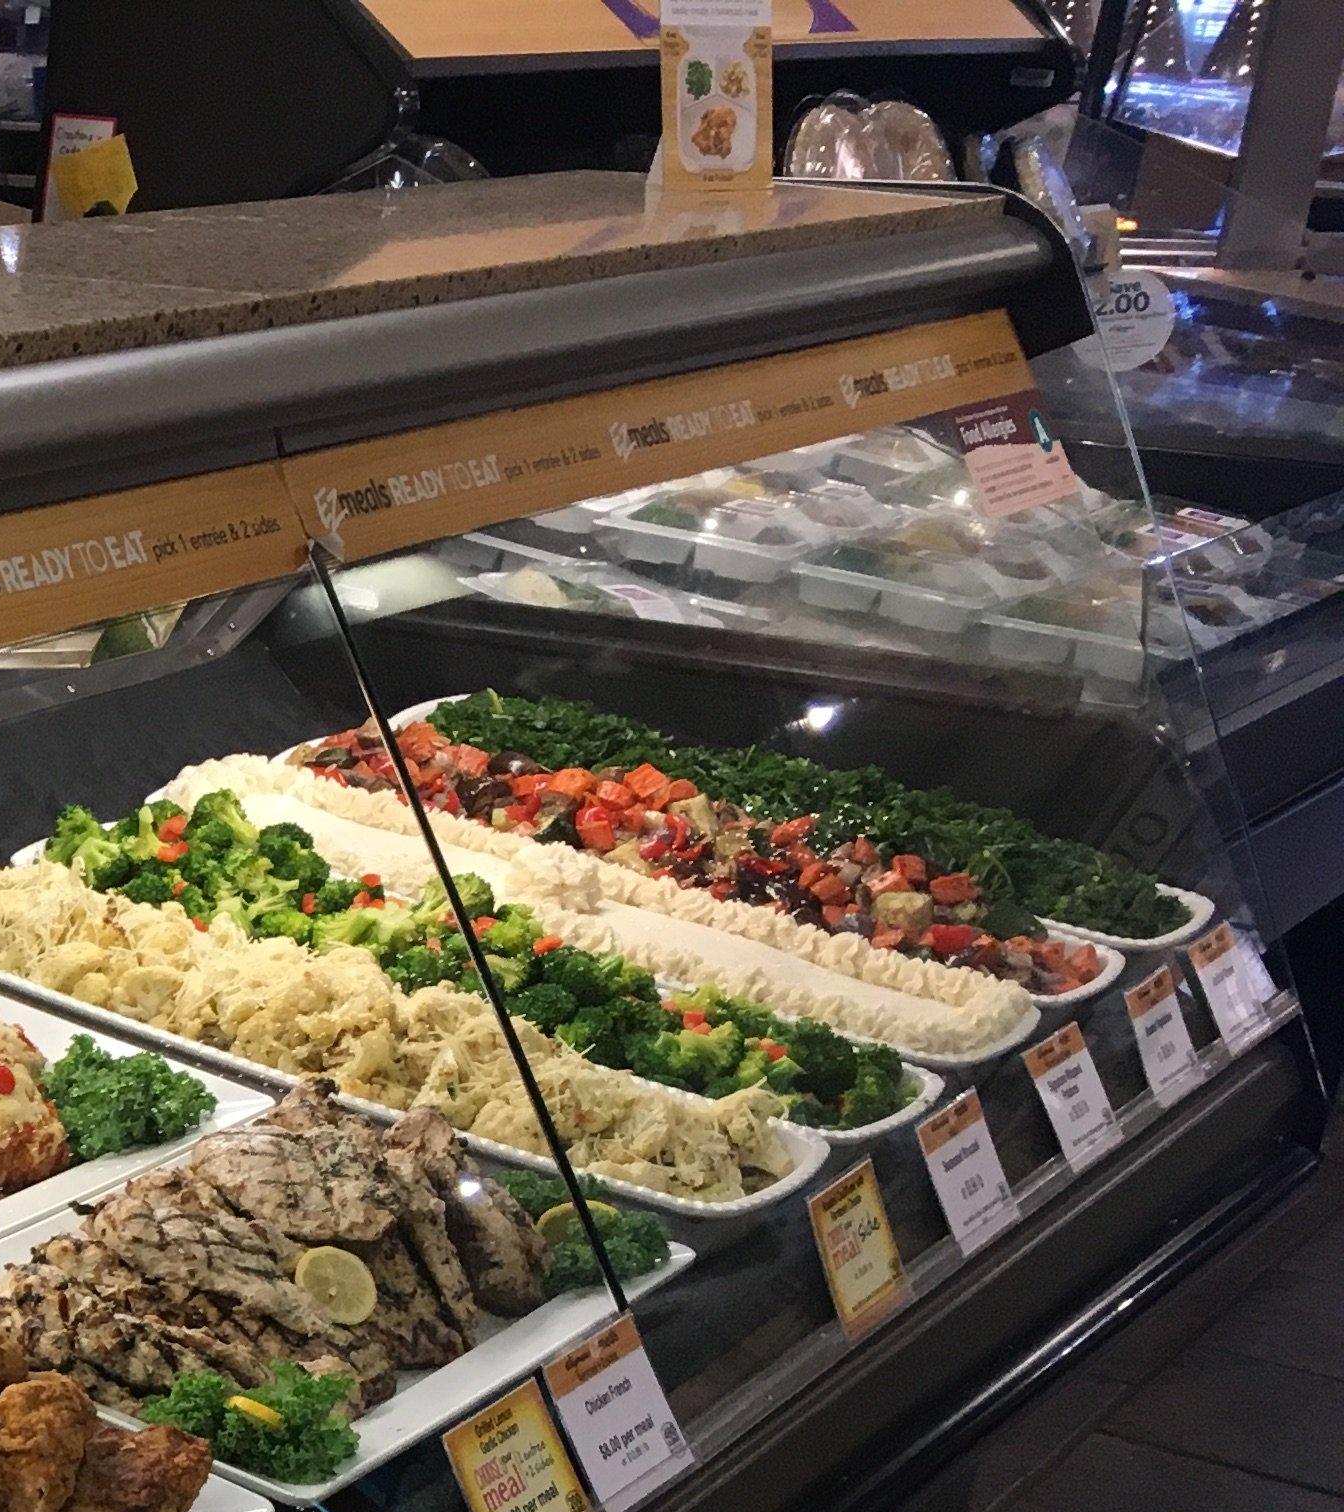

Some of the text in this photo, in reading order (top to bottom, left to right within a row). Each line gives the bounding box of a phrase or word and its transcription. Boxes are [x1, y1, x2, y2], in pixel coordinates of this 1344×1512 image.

[387, 467, 447, 506] READY
[444, 460, 472, 490] TO
[470, 454, 501, 487] EAT
[72, 540, 106, 575] TO
[106, 530, 148, 569] EAT
[152, 539, 176, 564] pick
[178, 536, 188, 553] 1
[228, 524, 241, 542] &
[242, 521, 251, 539] 2
[251, 515, 281, 537] sides
[537, 1480, 559, 1506] meal
